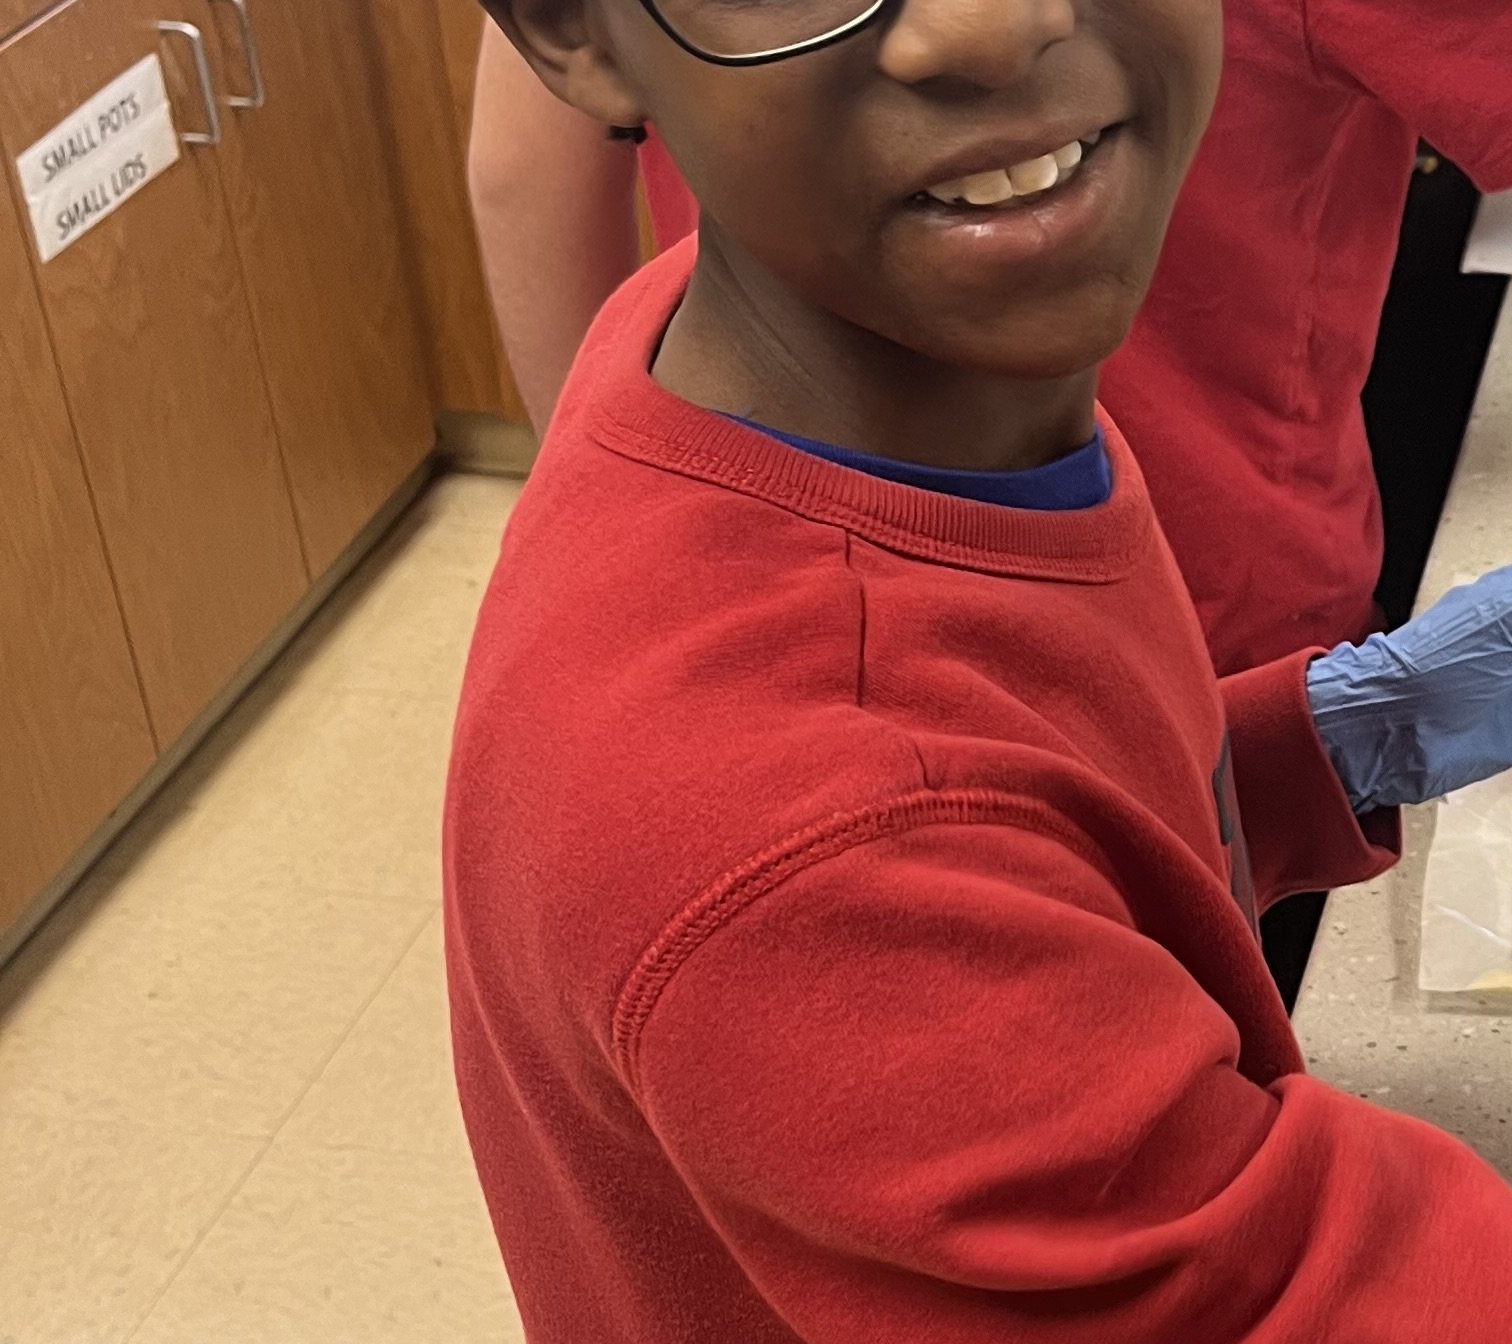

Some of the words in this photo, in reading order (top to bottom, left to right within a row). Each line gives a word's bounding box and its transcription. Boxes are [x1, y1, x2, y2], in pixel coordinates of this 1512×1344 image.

[41, 124, 98, 184] SMALL
[97, 92, 142, 141] POTS
[55, 181, 112, 241] SMALL
